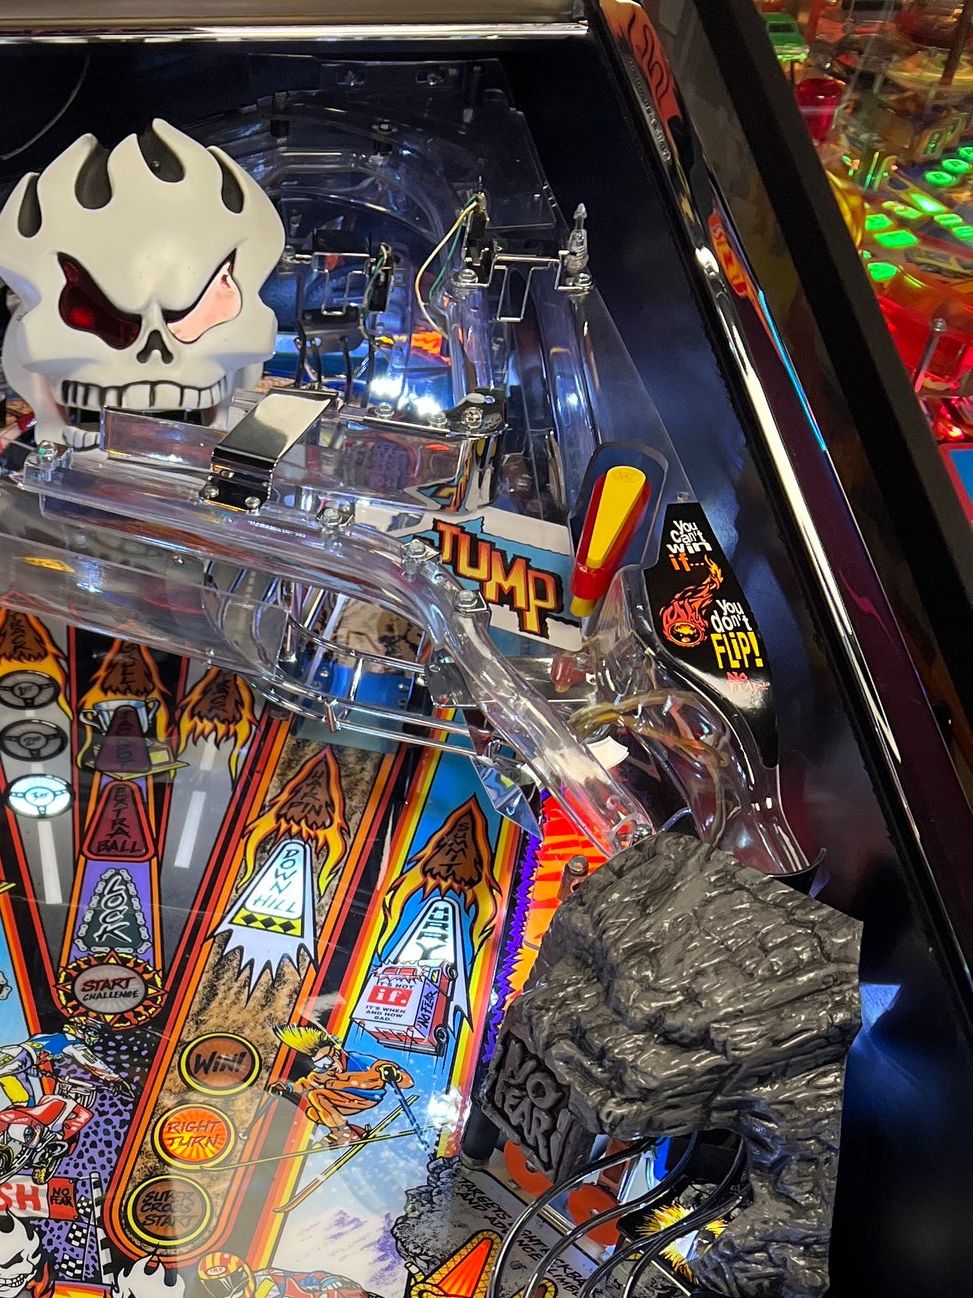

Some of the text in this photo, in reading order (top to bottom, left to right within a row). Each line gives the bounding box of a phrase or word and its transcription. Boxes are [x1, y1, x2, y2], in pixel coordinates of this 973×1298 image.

[670, 529, 706, 544] can't
[667, 542, 712, 554] win
[432, 519, 558, 634] JUMP
[711, 610, 753, 633] don't
[105, 786, 131, 839] EXTRA
[97, 840, 143, 853] BALL
[270, 849, 300, 894] DOWN
[93, 875, 133, 942] LOCK
[253, 895, 297, 914] HILL
[415, 906, 450, 960] HURRY
[81, 976, 137, 992] START
[83, 989, 139, 1001] CHALLENGE
[194, 1047, 245, 1075] WIN!
[166, 1119, 221, 1137] RIGHT
[167, 1131, 219, 1150] TURN
[140, 1190, 194, 1208] SUPER
[140, 1200, 188, 1216] CROSS
[141, 1211, 194, 1228] START
